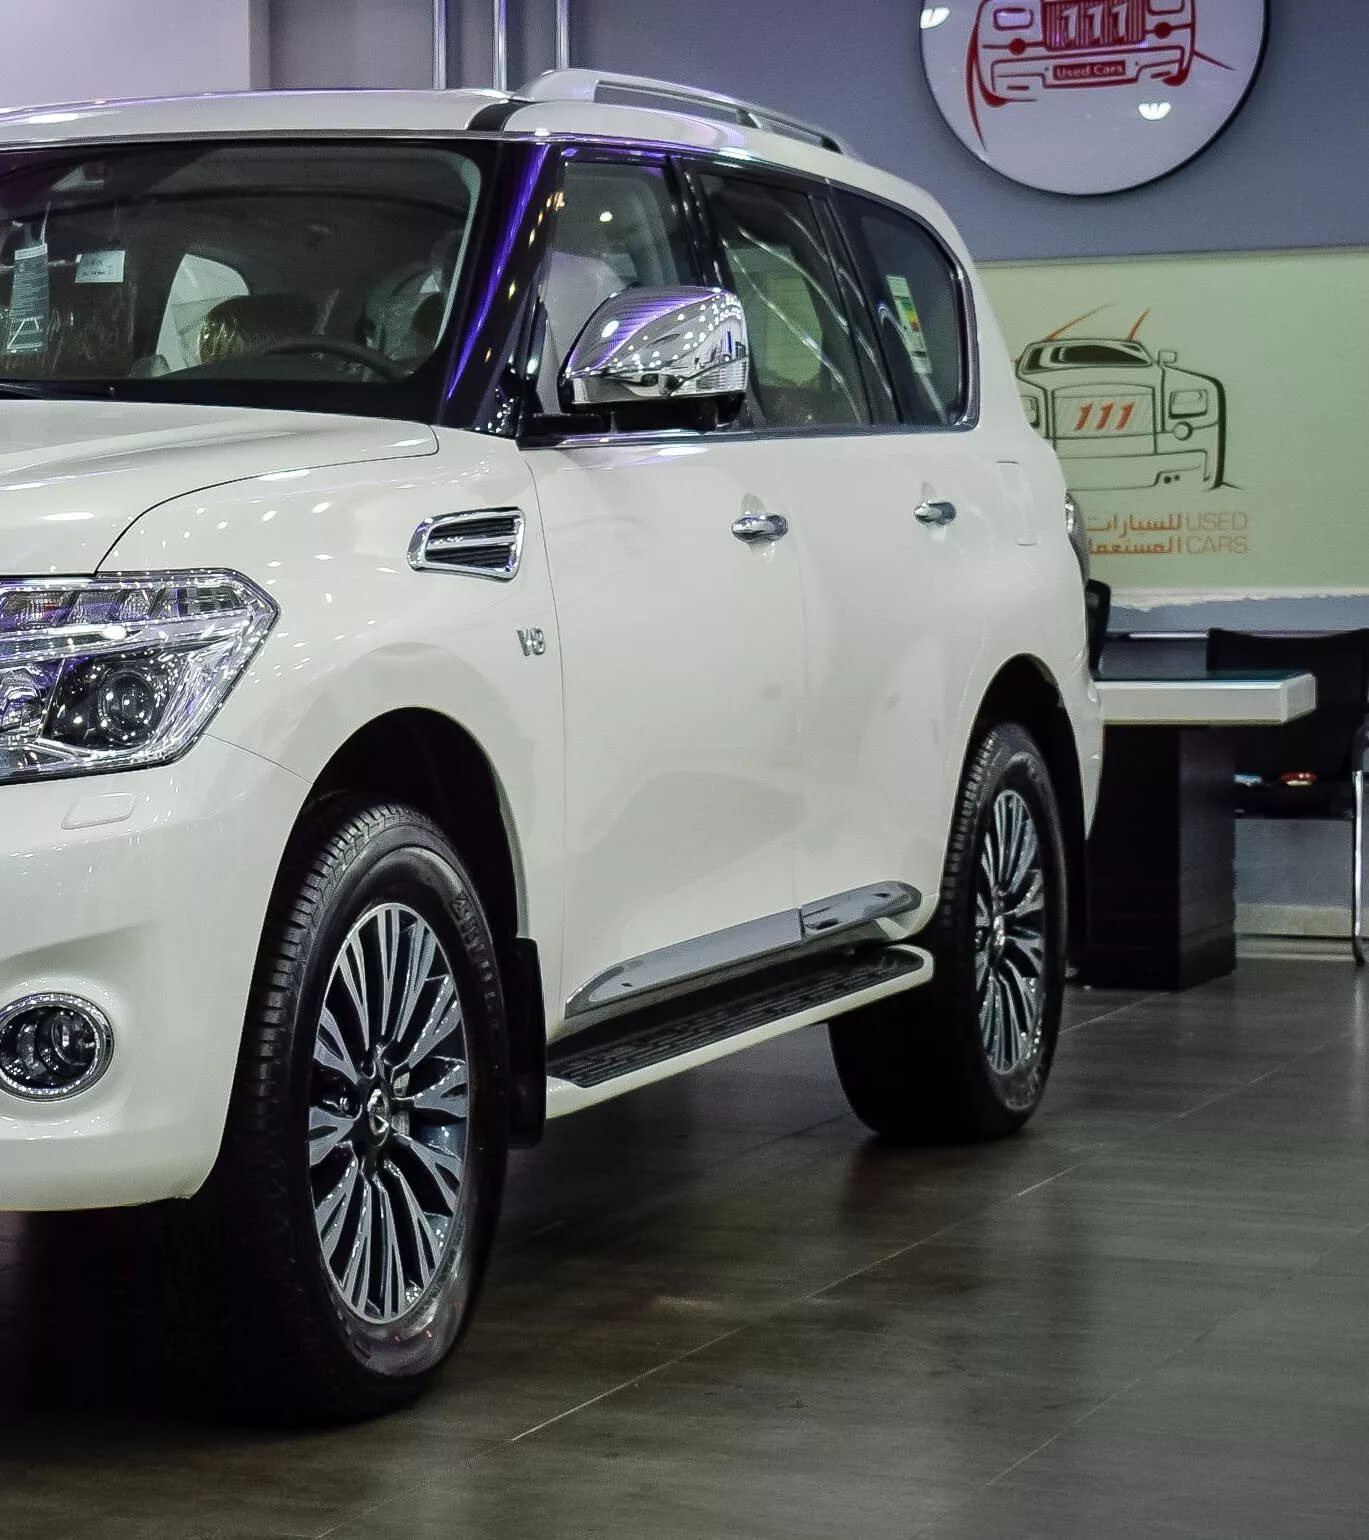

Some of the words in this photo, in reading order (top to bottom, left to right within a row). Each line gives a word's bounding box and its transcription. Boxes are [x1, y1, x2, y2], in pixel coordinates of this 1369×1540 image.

[1062, 3, 1128, 39] 111
[1056, 65, 1090, 78] Used
[1092, 63, 1123, 76] Cars
[1074, 401, 1136, 430] 111
[1185, 511, 1248, 532] USED
[1088, 535, 1181, 555] المستعمل
[1185, 534, 1249, 555] CARS
[516, 627, 546, 657] V8
